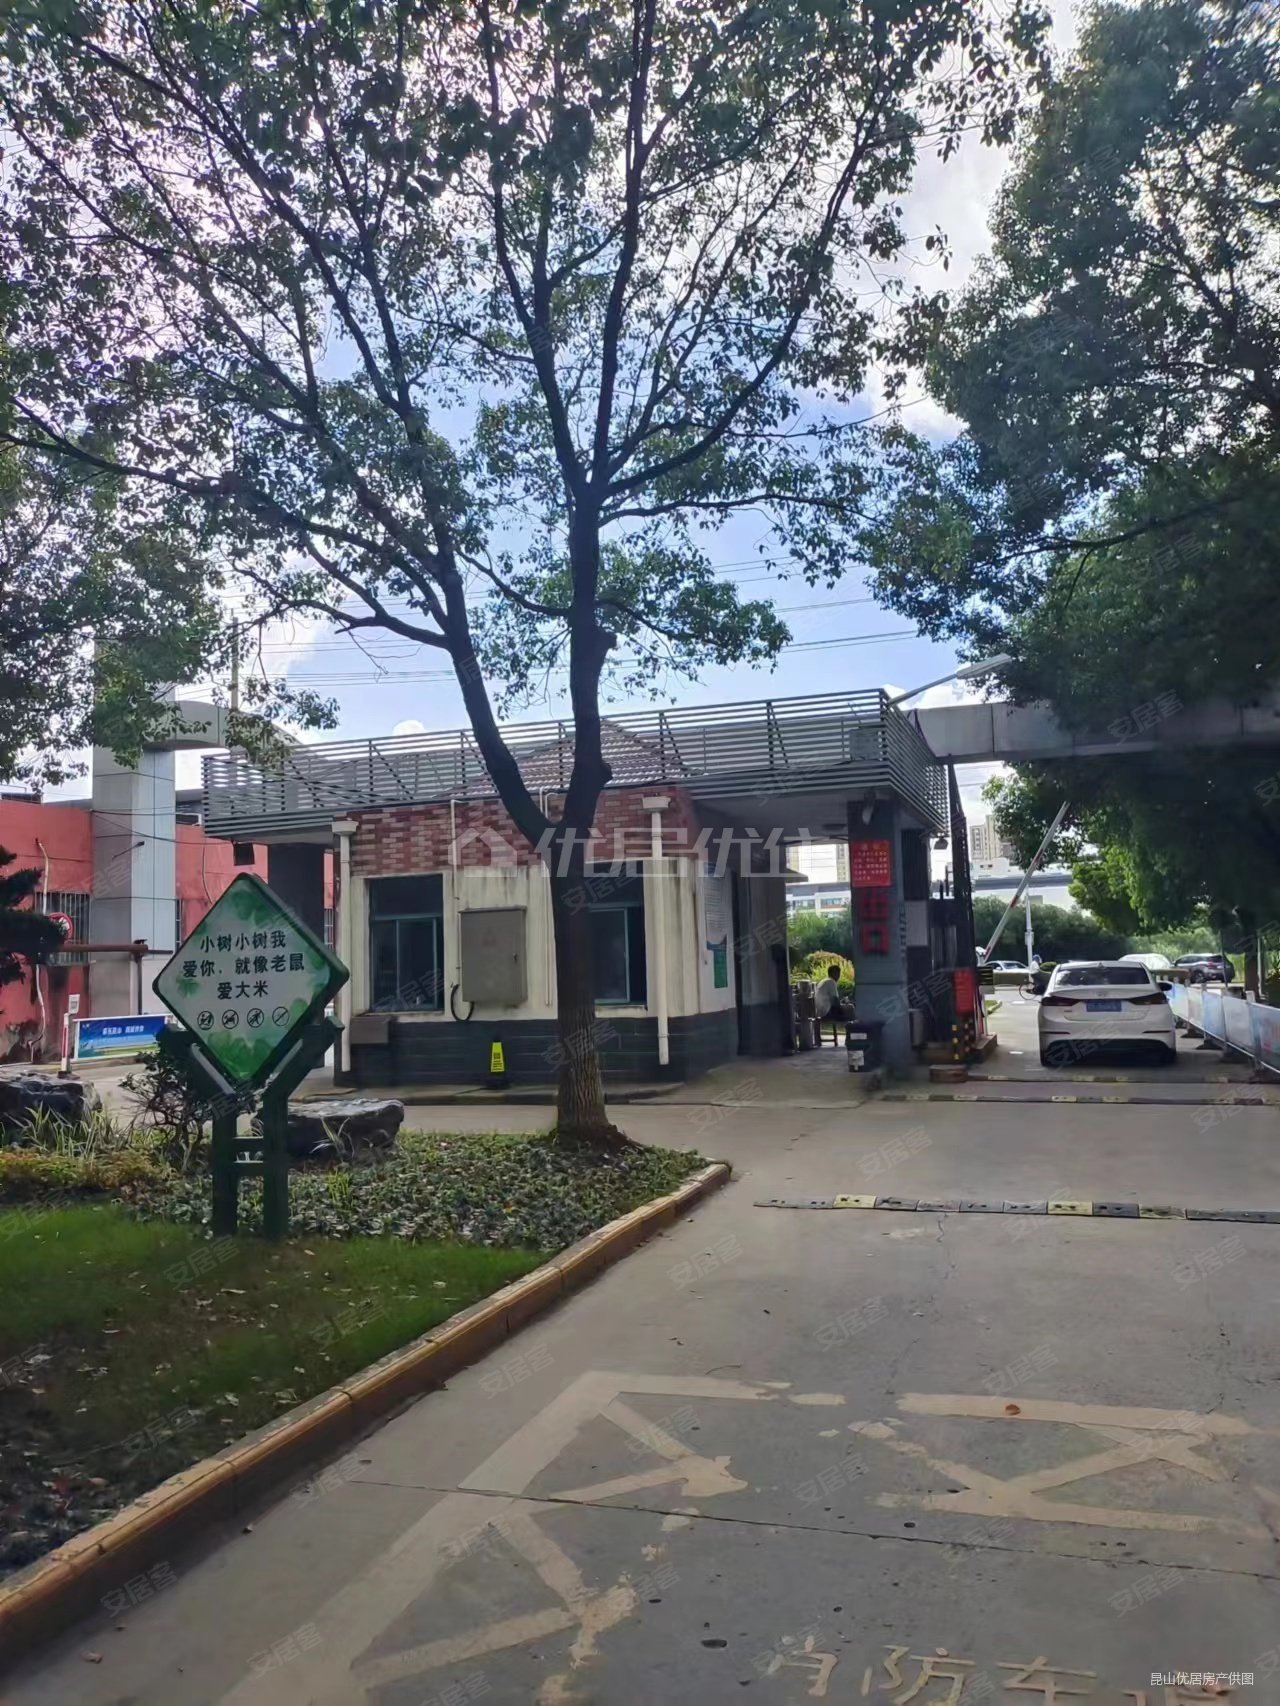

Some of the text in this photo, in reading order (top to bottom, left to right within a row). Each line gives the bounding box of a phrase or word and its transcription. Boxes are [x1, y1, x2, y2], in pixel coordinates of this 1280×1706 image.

[200, 930, 286, 953] 小树小树我
[217, 980, 268, 1000] 爱大米
